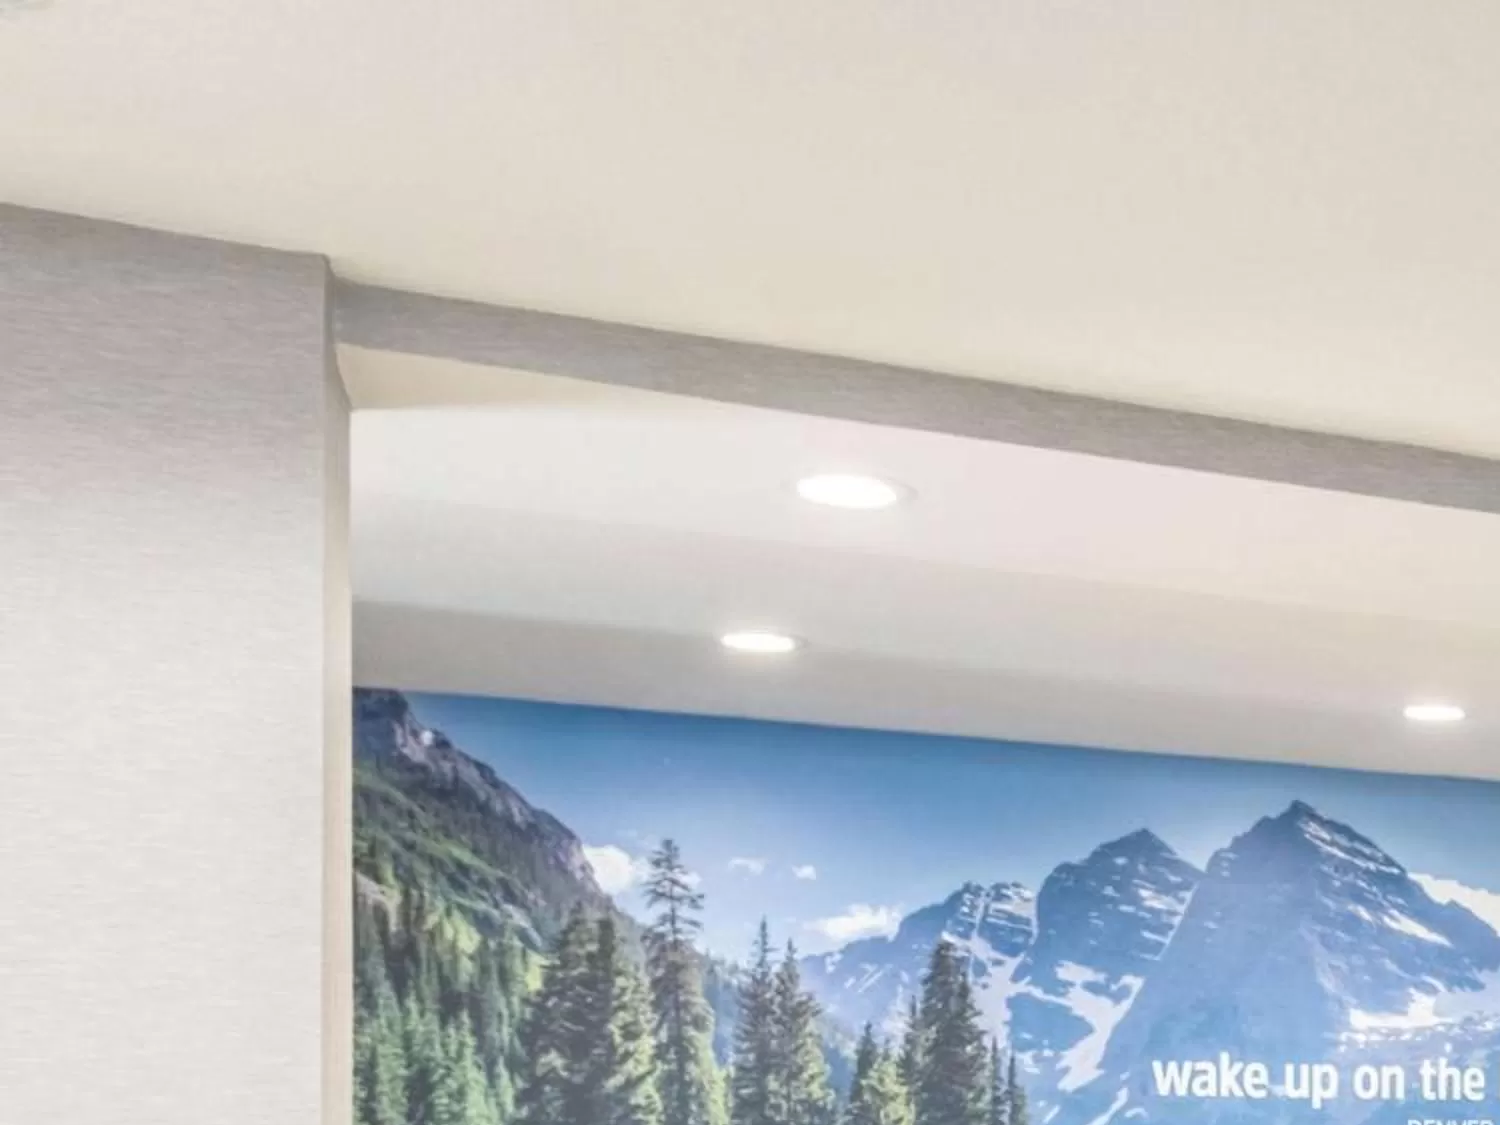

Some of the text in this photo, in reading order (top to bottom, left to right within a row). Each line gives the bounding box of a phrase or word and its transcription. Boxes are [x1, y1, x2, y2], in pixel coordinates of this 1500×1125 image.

[1152, 1052, 1270, 1099] wake
[1285, 1064, 1339, 1109] up
[1354, 1064, 1404, 1101] on
[1419, 1057, 1486, 1102] the
